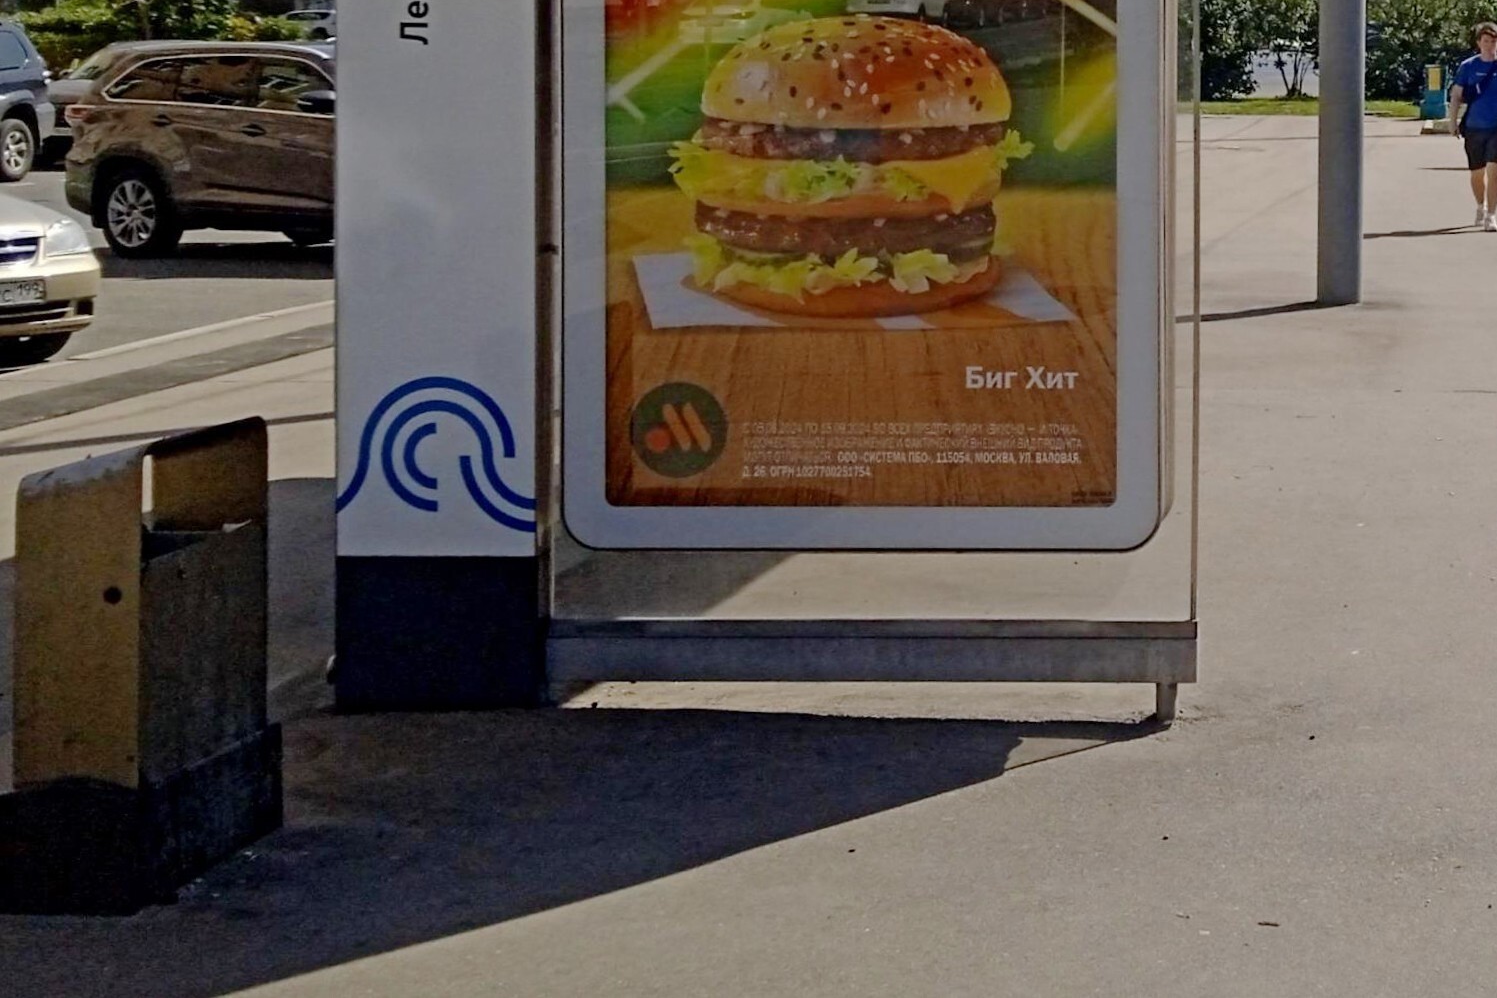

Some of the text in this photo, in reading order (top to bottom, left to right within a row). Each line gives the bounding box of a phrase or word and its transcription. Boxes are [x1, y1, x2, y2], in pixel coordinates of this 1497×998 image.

[964, 365, 1079, 391] Биг Хит
[837, 451, 858, 463] ООО
[770, 466, 795, 478] ОГРН
